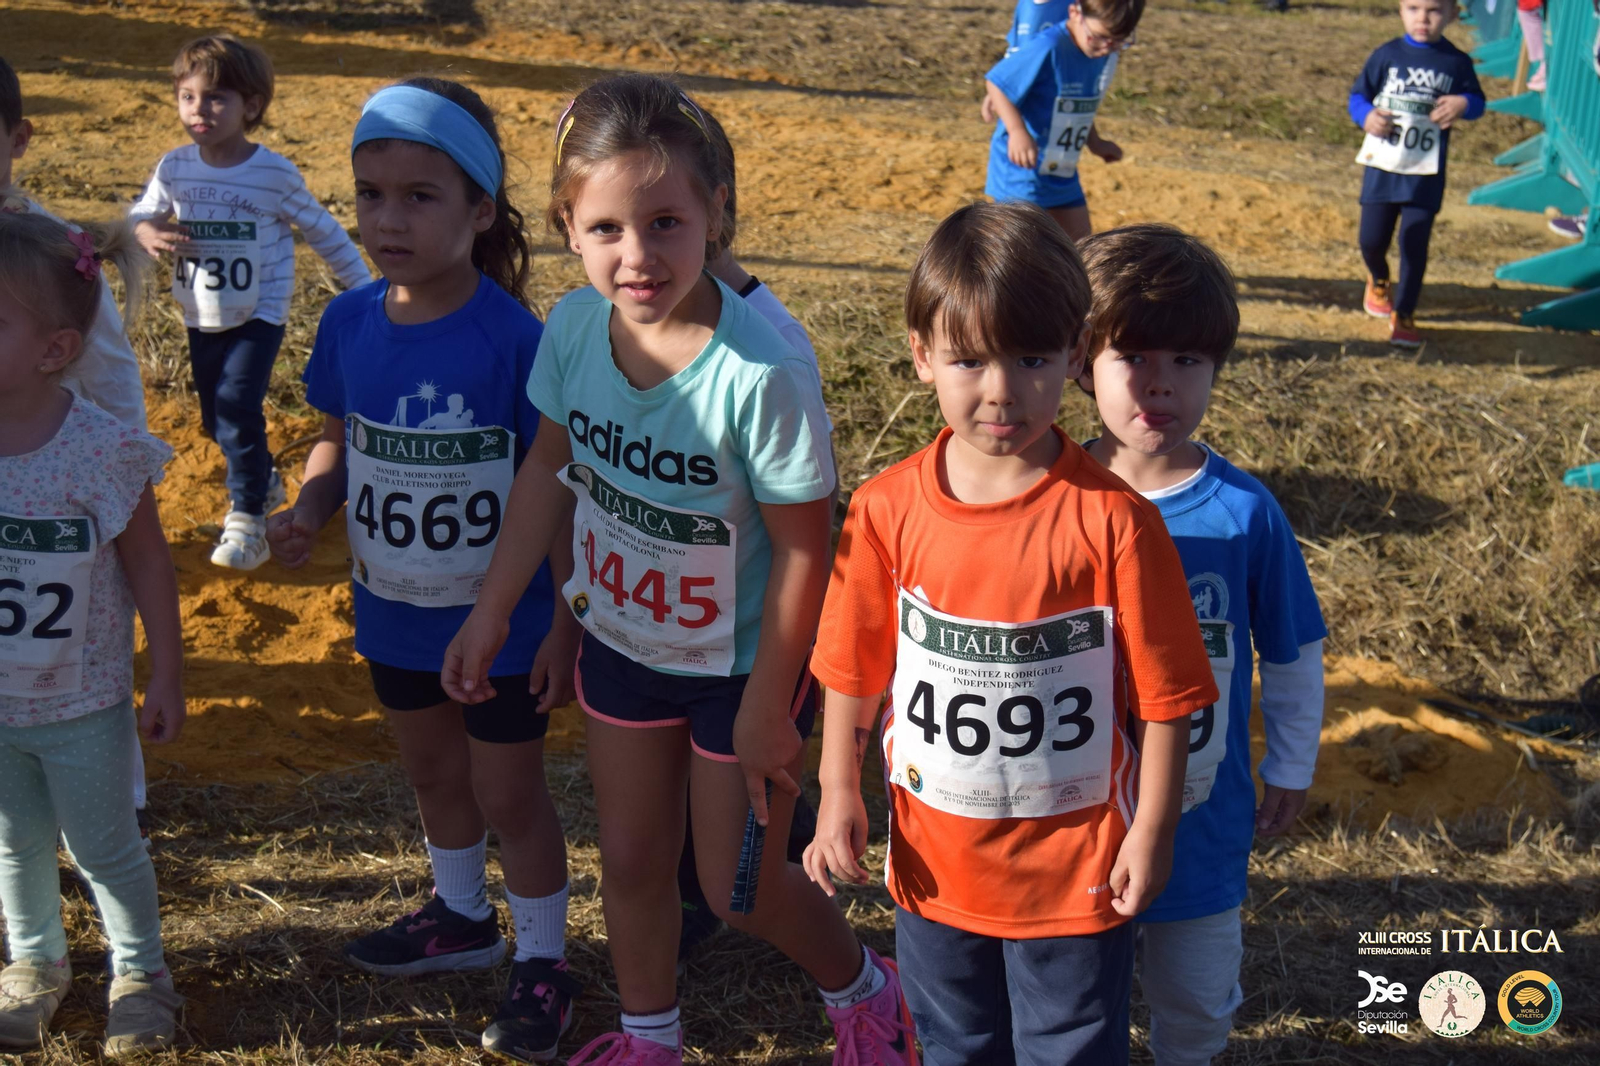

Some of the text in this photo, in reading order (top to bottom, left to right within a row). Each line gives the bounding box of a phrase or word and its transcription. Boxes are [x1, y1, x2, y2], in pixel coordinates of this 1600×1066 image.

[1388, 124, 1435, 152] 606
[180, 187, 217, 202] INTER
[189, 222, 229, 237] ÁLICA
[176, 256, 253, 292] 4730
[376, 434, 466, 460] ITÁLICA
[479, 452, 499, 461] Sevilla
[568, 409, 719, 487] adidas
[372, 474, 472, 489] CLUB ATLETISMO ORIPPO
[376, 466, 467, 480] DANIEL MORENO VEGA
[355, 483, 501, 551] 4669
[598, 483, 676, 536] ITÁLICA
[605, 528, 661, 560] TROTACOLONIA
[617, 525, 637, 541] ROSSI
[637, 536, 686, 557] ESCRIBANO
[7, 556, 36, 566] NIETO
[584, 527, 719, 630] 4445
[0, 578, 74, 639] 62
[939, 628, 1051, 656] ITÁLICA
[940, 648, 994, 661] INTERNATIONAL
[1019, 653, 1052, 662] COUNTRY
[1067, 640, 1092, 653] Sevilla
[928, 658, 1064, 679] DIEGO BENÍTEZ RODRÍGUEZ
[953, 676, 1035, 689] INDEPENDIENTE
[906, 679, 1095, 758] 4693
[935, 787, 952, 796] CROSS
[952, 793, 998, 802] INTERNACIONAL
